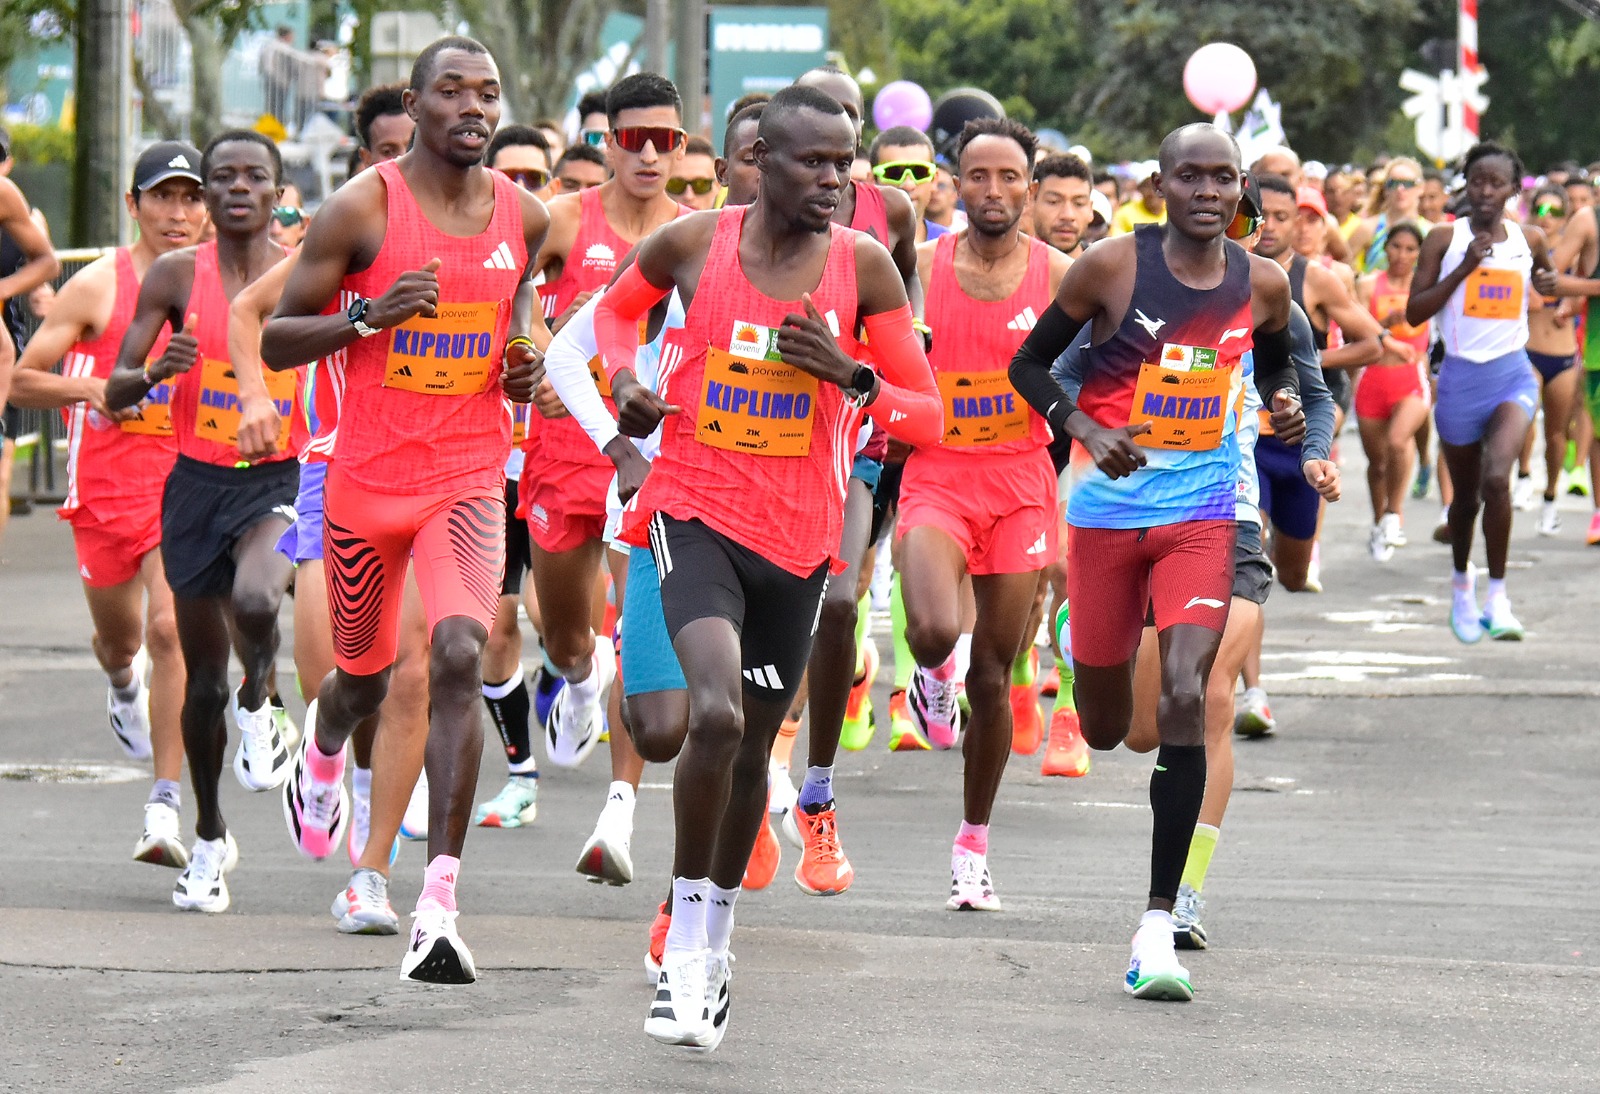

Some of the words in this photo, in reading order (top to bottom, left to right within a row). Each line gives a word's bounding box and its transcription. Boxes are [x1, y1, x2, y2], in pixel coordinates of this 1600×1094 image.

[582, 259, 617, 267] porvenir
[441, 310, 479, 319] porvenir
[393, 329, 491, 359] KIPRUTO
[730, 342, 761, 354] porvenir
[751, 366, 798, 378] porvenir
[1181, 375, 1217, 385] porvenir
[705, 380, 811, 420] KIPLIMO
[952, 392, 1015, 418] HABTE
[1142, 392, 1221, 420] MATATA
[746, 428, 760, 437] 21K
